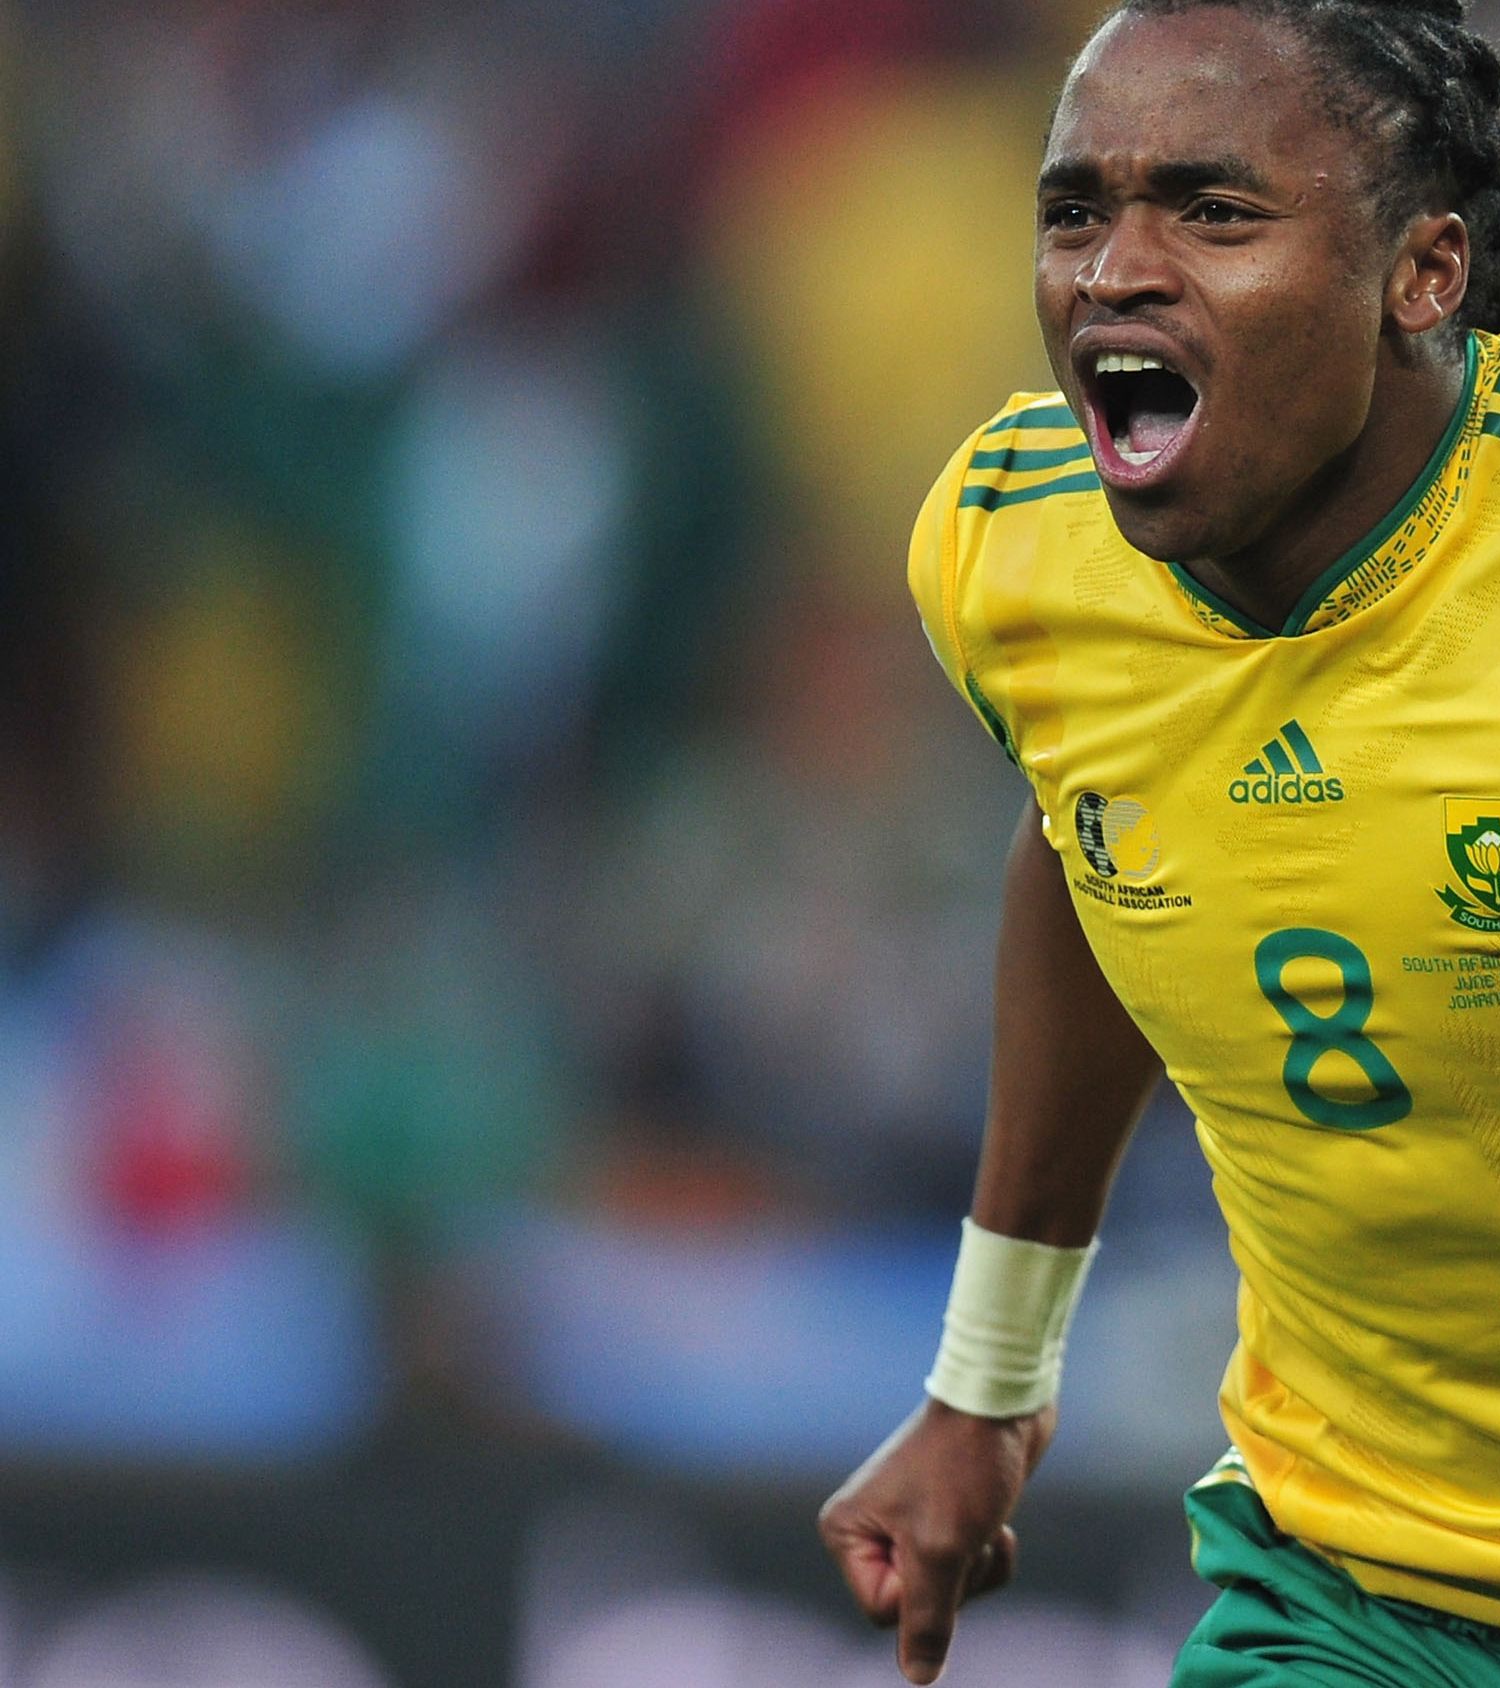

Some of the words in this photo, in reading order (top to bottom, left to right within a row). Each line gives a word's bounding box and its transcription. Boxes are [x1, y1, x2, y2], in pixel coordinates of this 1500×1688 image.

[1228, 774, 1344, 803] adidas
[1118, 884, 1165, 897] AFRICAN
[1118, 895, 1192, 910] ASSOCIATION
[1459, 911, 1500, 929] SOUTH
[1402, 957, 1454, 973] SOUTH
[1254, 927, 1413, 1131] 8
